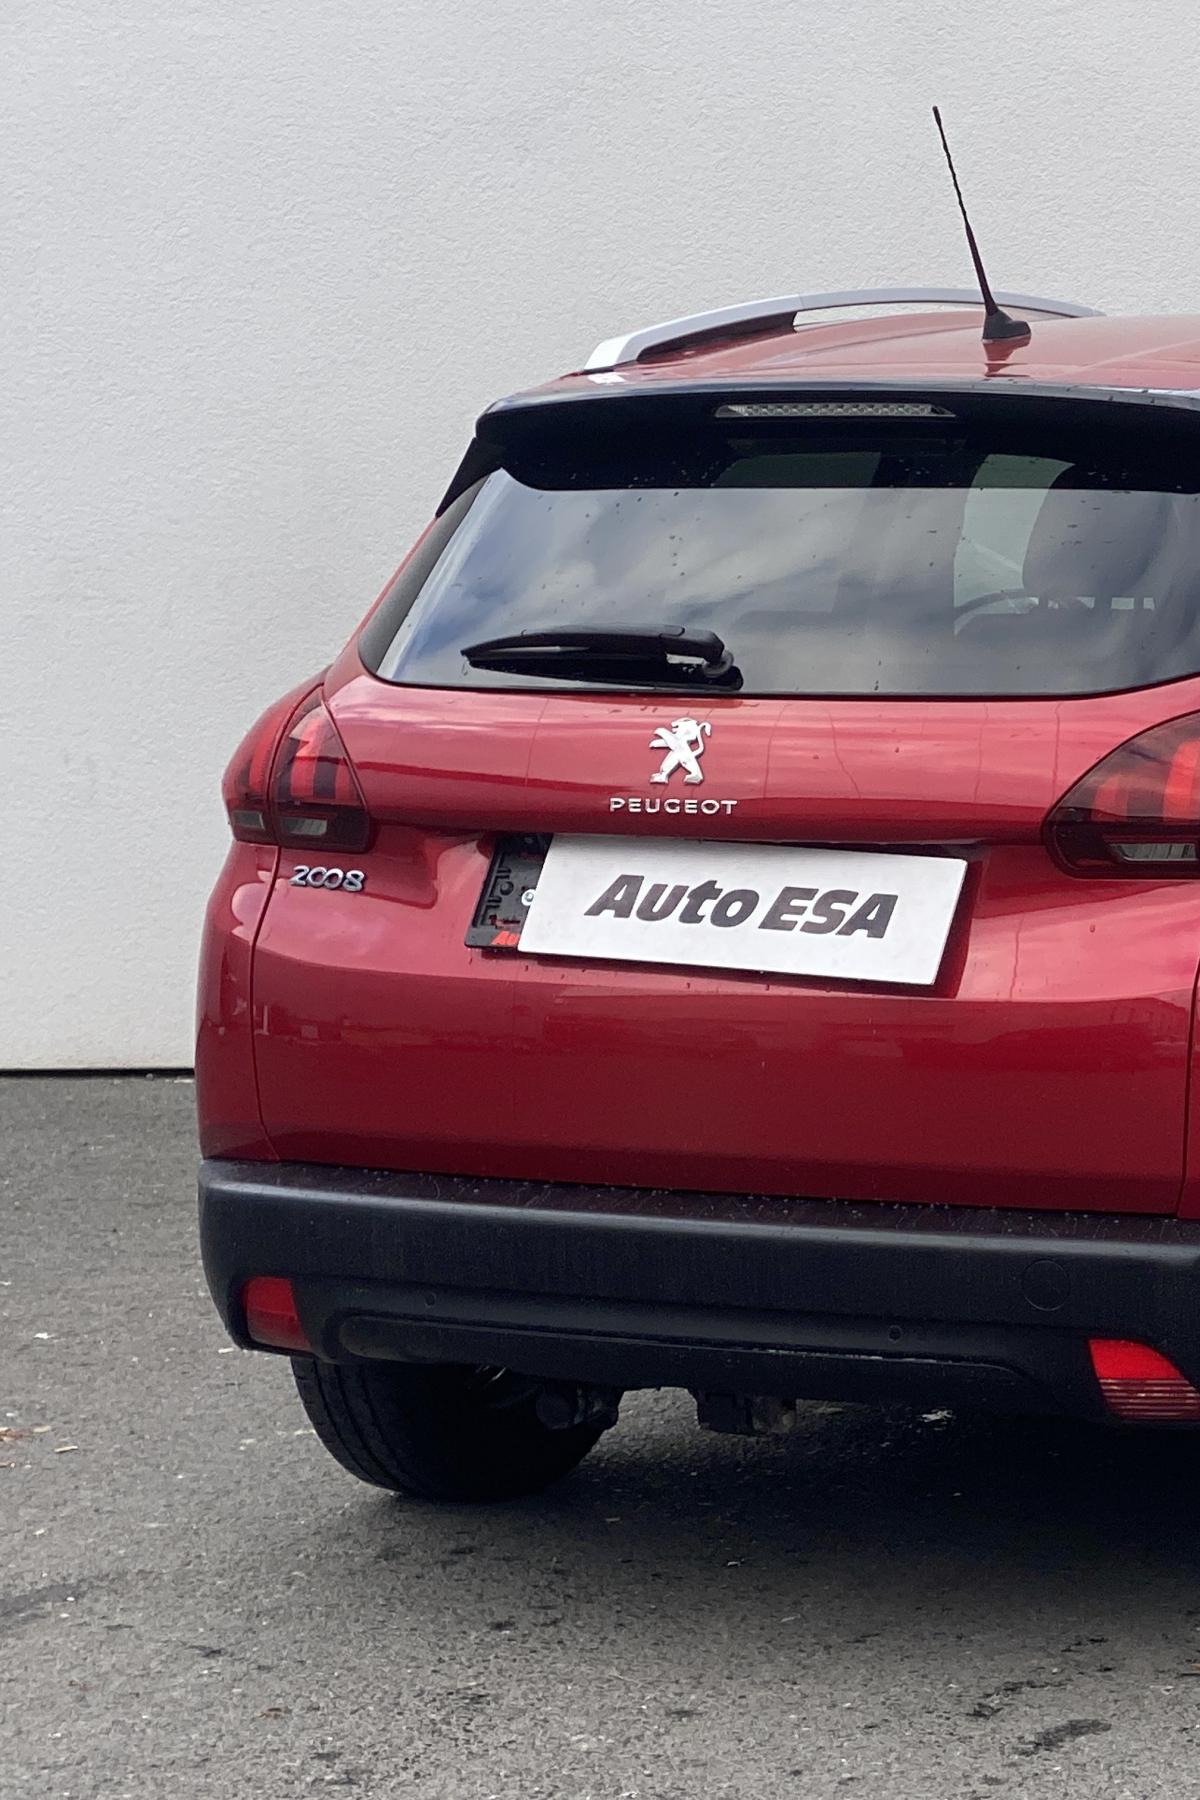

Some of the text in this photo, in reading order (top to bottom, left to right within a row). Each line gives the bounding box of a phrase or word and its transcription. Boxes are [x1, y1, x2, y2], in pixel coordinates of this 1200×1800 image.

[609, 797, 738, 815] PEUGEOT
[289, 864, 366, 892] 2008
[584, 874, 898, 939] Auto ESA
